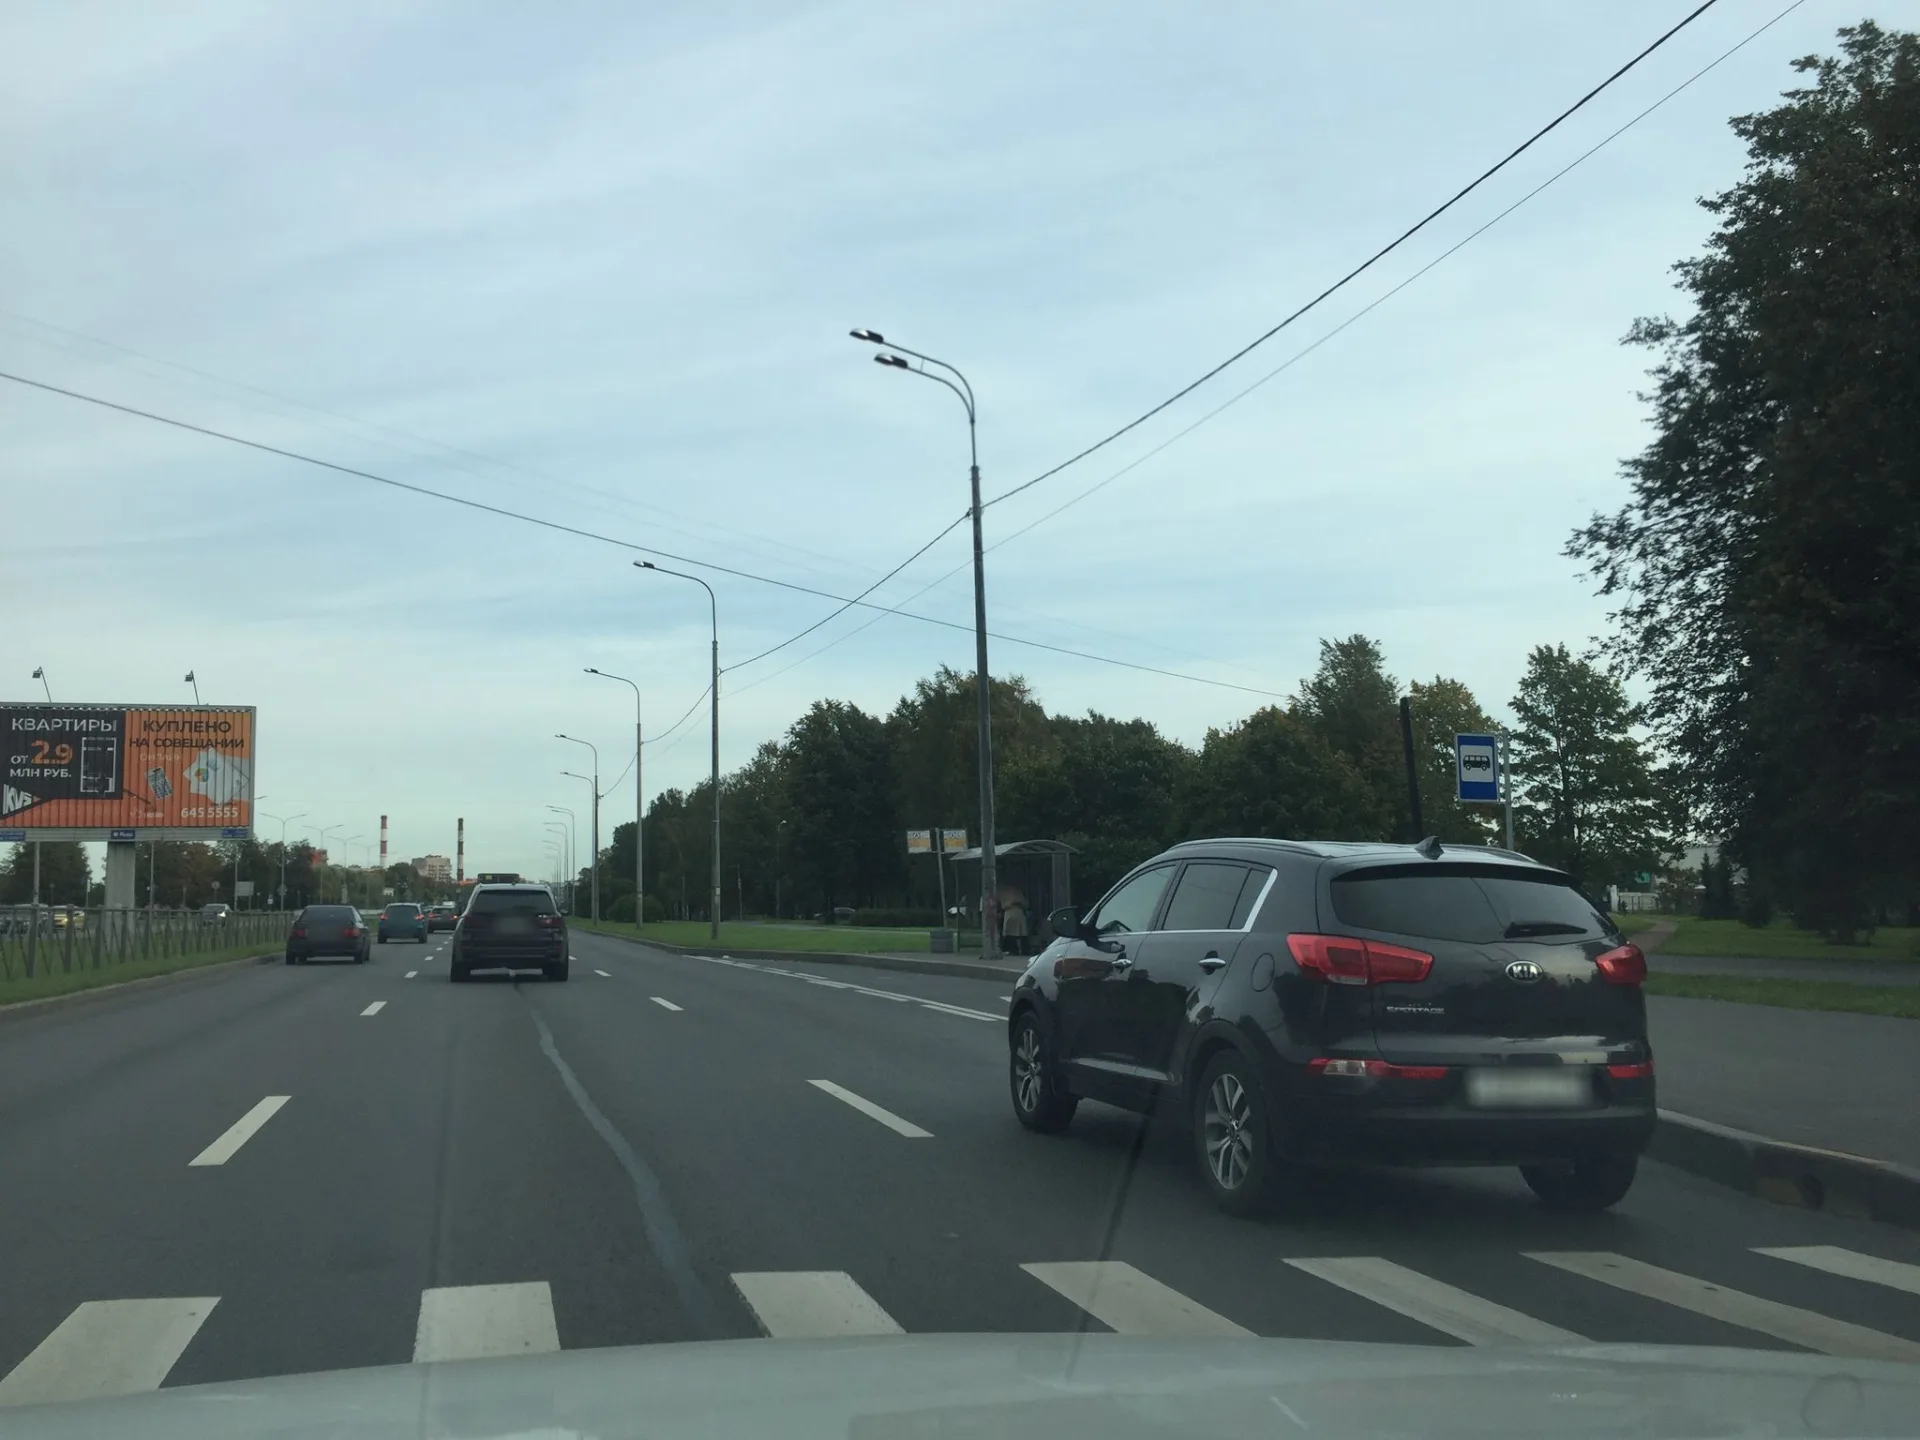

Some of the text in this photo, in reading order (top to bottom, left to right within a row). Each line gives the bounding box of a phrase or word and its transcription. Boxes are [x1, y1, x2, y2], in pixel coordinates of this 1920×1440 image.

[11, 718, 117, 732] КВАРТИРЫ
[143, 720, 232, 733] КУПЛЕНО
[129, 738, 245, 749] НА СОВЕЩАНИИ
[10, 755, 29, 764] ОТ
[9, 768, 72, 778] МЛН РУБ.
[1511, 964, 1539, 978] KIA
